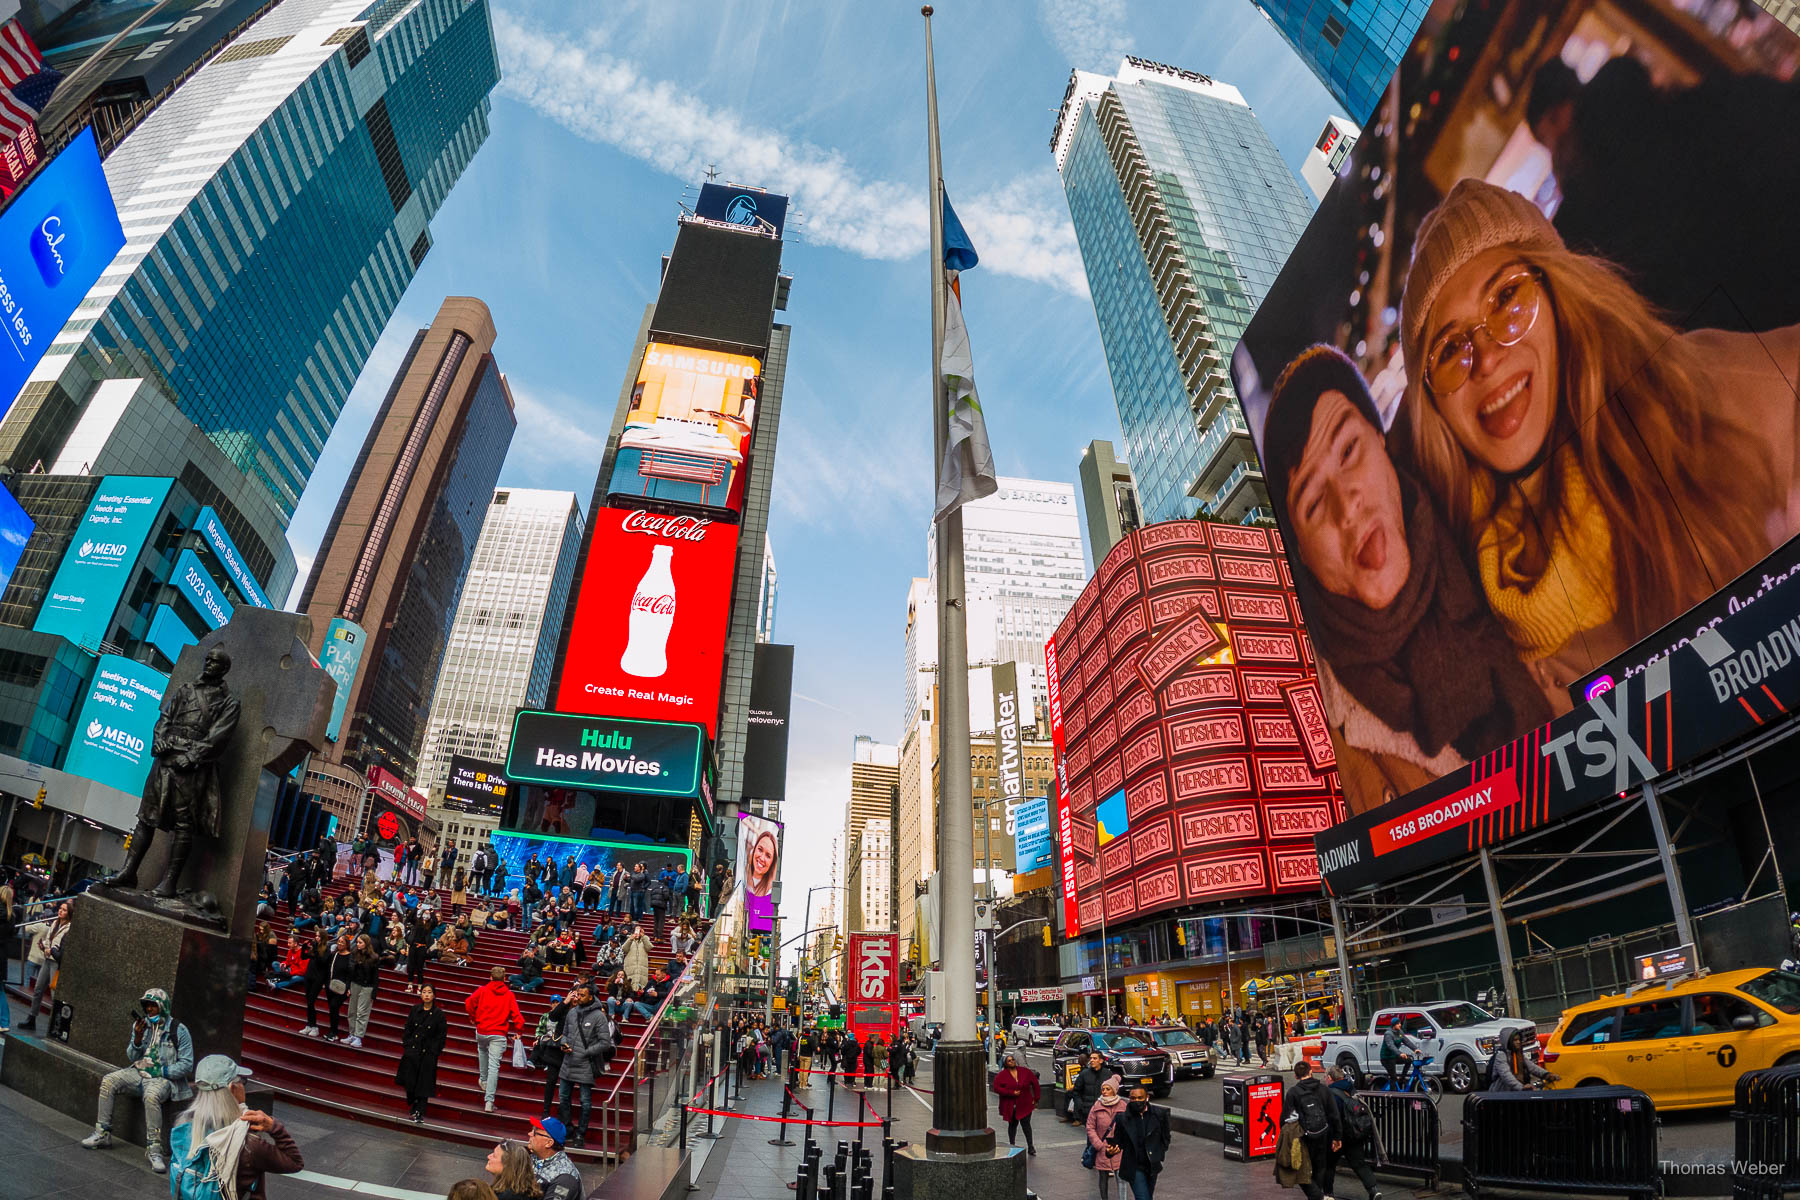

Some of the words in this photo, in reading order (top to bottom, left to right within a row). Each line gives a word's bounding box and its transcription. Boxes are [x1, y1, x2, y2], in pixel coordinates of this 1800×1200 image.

[1322, 127, 1339, 155] RIU
[41, 215, 66, 274] Calm
[12, 307, 32, 346] less
[646, 351, 755, 380] SAMSUNG
[94, 505, 113, 513] Needs
[99, 494, 123, 504] Meeting
[123, 496, 153, 505] Essential
[1011, 490, 1068, 505] BARCLAYS
[622, 510, 712, 542] Coca-Cola
[1142, 524, 1199, 546] HERSHEY'S
[1213, 529, 1264, 546] HERSHEY'S
[93, 543, 128, 556] MEND
[207, 519, 226, 553] Morgan
[224, 548, 242, 580] Stanley
[1151, 559, 1208, 580] HERSHEY'S
[1222, 561, 1273, 578] HERSHEY'S
[185, 566, 206, 597] 2023
[203, 589, 229, 628] Strateg
[1230, 598, 1282, 616] HERSHEY'S
[1111, 612, 1140, 647] HERSHEY'S
[1145, 623, 1209, 679] HERSHEY'S
[1240, 638, 1292, 655] HERSHEY'S
[96, 681, 118, 693] Needs
[120, 688, 137, 700] with
[100, 670, 128, 686] Meeting
[129, 679, 162, 701] Essential
[584, 684, 625, 697] Create
[628, 689, 655, 701] Real
[658, 692, 694, 706] Magic
[1046, 643, 1062, 731] CHOCOLATE
[1168, 676, 1231, 700] HERSHEY'S
[93, 691, 118, 706] Dignity,
[120, 700, 134, 712] Inc.
[1121, 692, 1151, 724] HERSHEY'S
[103, 725, 144, 752] MEND
[1174, 720, 1239, 746] HERSHEY'S
[1295, 690, 1334, 761] HERSHEY'S
[1541, 679, 1660, 794] TSX
[581, 728, 633, 750] Hulu
[536, 748, 577, 768] Has
[1126, 737, 1158, 768] HERSHEY'S
[453, 776, 474, 787] There
[482, 783, 492, 791] No
[458, 768, 475, 778] Text
[475, 772, 487, 782] OR
[1178, 765, 1244, 792] HERSHEY'S
[1129, 780, 1163, 811] HERSHEY'S
[1185, 813, 1252, 839] HERSHEY'S
[1271, 810, 1328, 830] HERSHEY'S
[1389, 820, 1416, 841] 1568
[1417, 786, 1492, 831] BROADWAY
[1061, 806, 1072, 857] COME
[1135, 827, 1167, 856] HERSHEY'S
[1141, 874, 1175, 900] HERSHEY'S
[1190, 861, 1260, 887] HERSHEY'S
[861, 939, 891, 998] tkts
